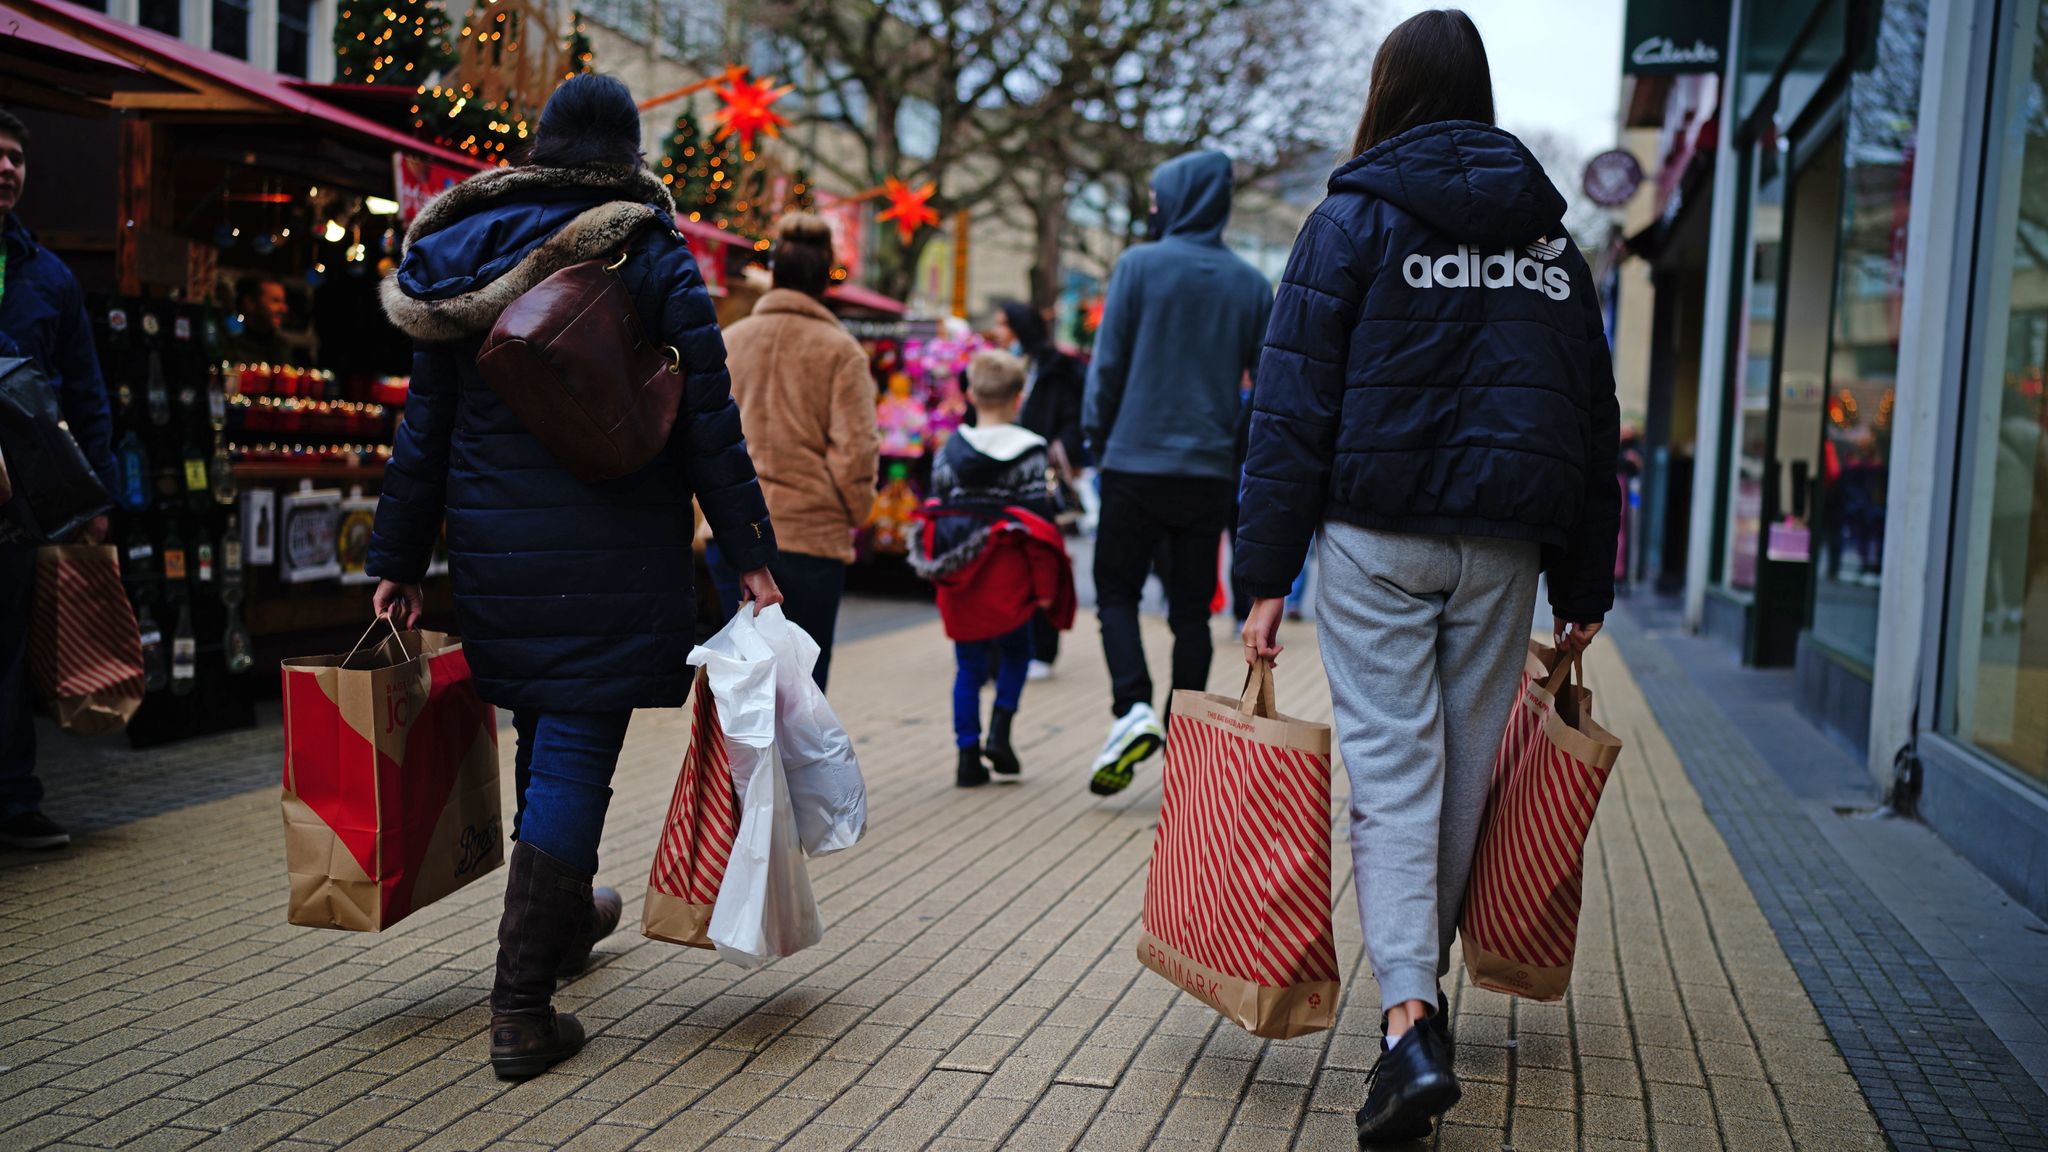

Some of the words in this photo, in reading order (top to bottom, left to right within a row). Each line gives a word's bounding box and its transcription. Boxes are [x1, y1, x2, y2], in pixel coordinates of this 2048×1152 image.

[1632, 33, 1720, 66] Clarks
[1402, 243, 1571, 301] adidas
[1147, 943, 1222, 1007] PRIMARK
